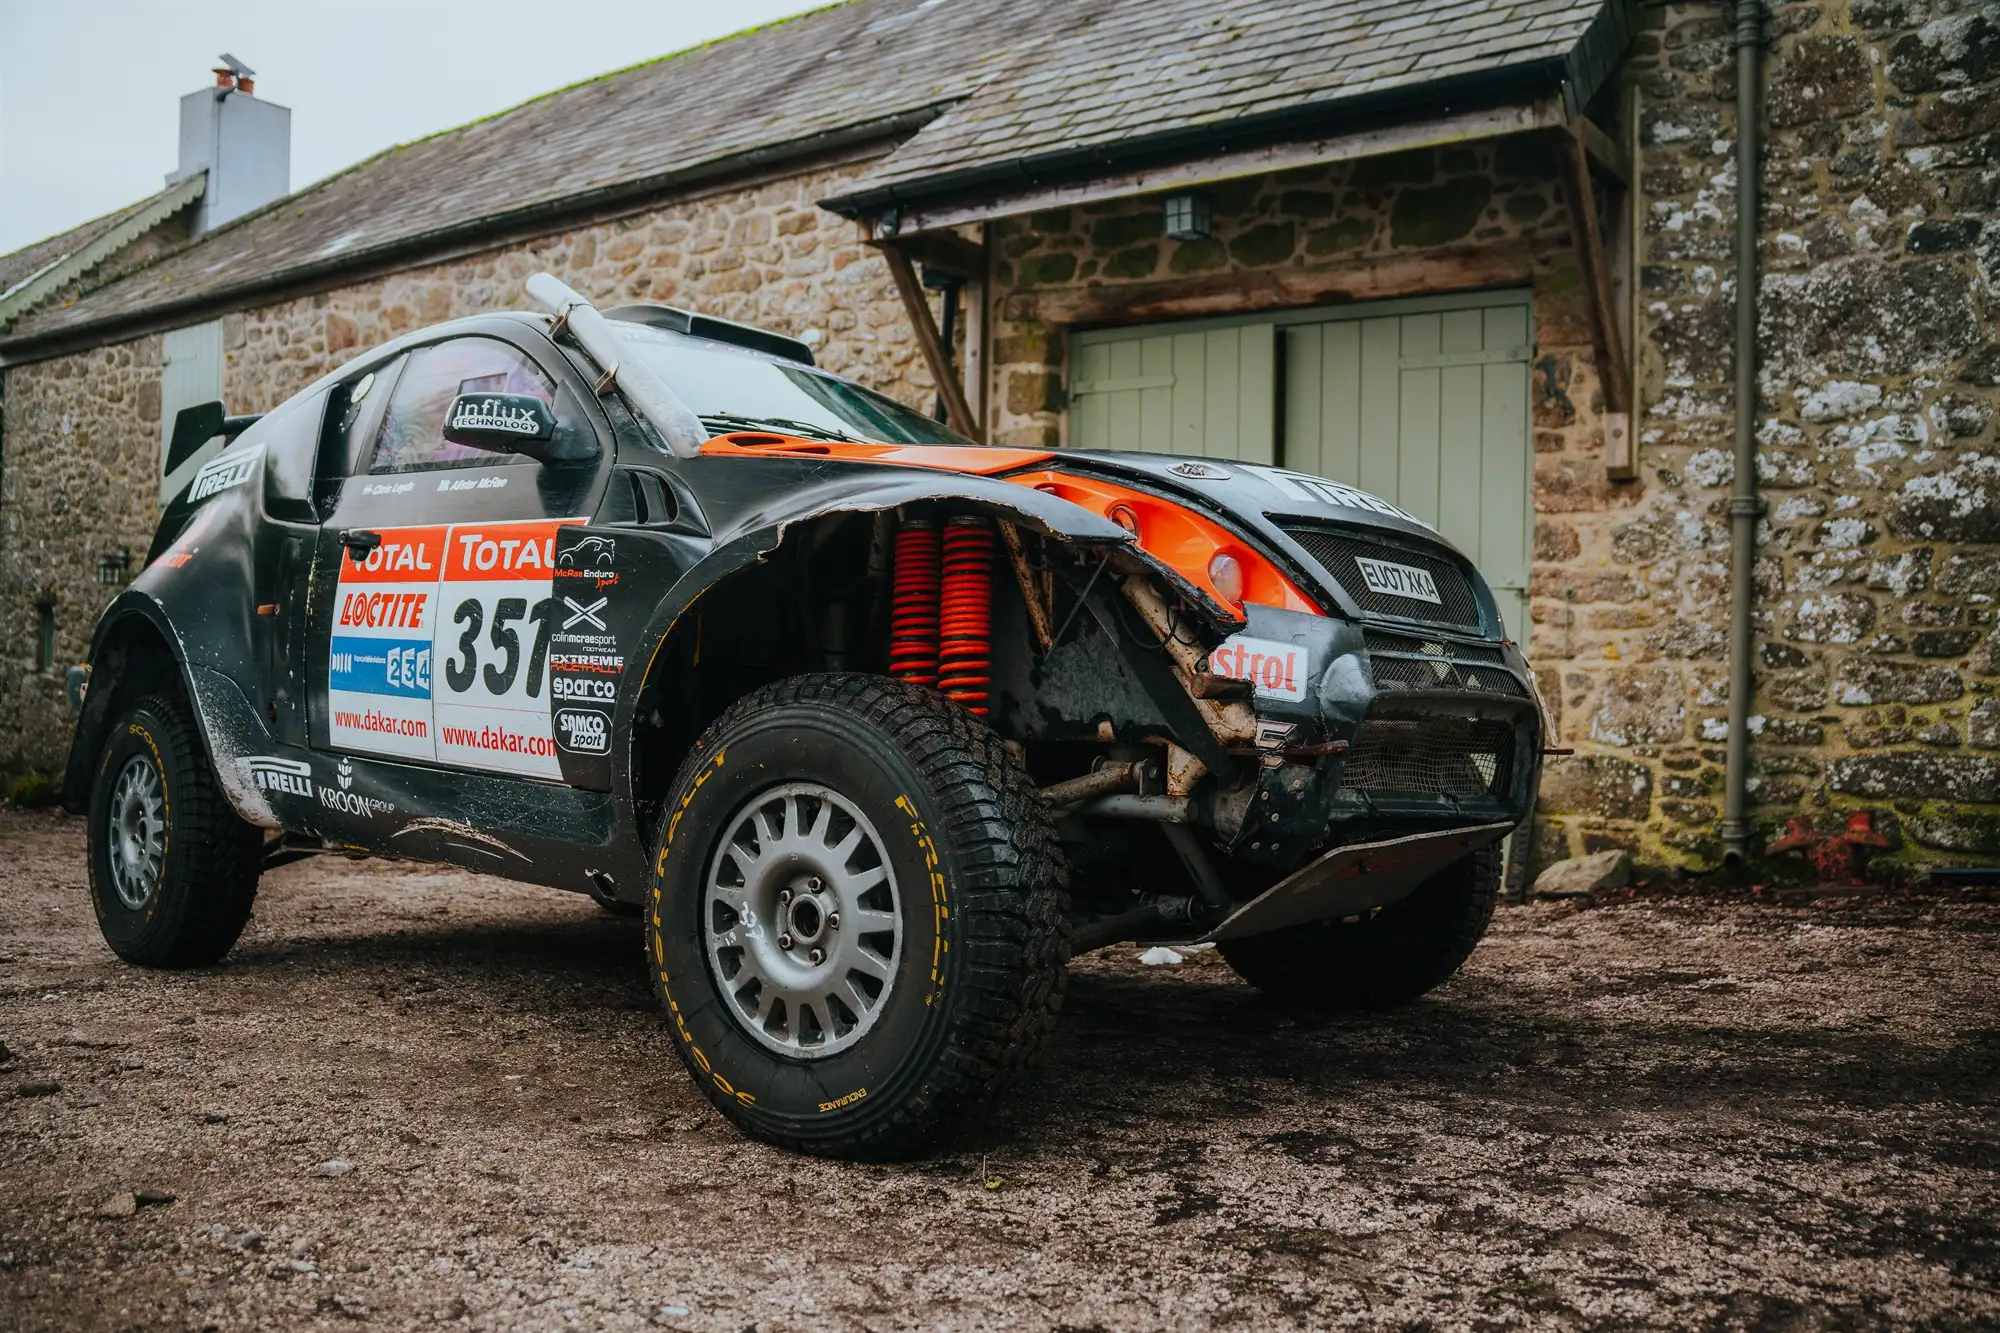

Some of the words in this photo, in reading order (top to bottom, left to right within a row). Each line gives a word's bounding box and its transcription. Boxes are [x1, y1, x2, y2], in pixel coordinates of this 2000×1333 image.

[456, 398, 536, 421] influx
[456, 417, 537, 431] TECHNOLOGY
[187, 442, 266, 504] PIRELLI
[352, 543, 432, 572] OTAL
[1360, 562, 1405, 592] EU07
[1402, 569, 1439, 599] XKA
[340, 592, 428, 628] LOCTITE
[445, 597, 552, 699] 351
[551, 631, 617, 646] colinmcraesport
[550, 654, 624, 667] EXTREME
[553, 677, 616, 701] sparco
[335, 708, 427, 738] www.dakar.com
[560, 713, 604, 734] SAMCO
[573, 733, 602, 747] sport
[318, 786, 374, 819] KROON
[370, 797, 395, 814] GROUP
[657, 748, 728, 878] RALLY
[653, 887, 756, 1109] SCORPION
[818, 1087, 868, 1113] ENDURANCE
